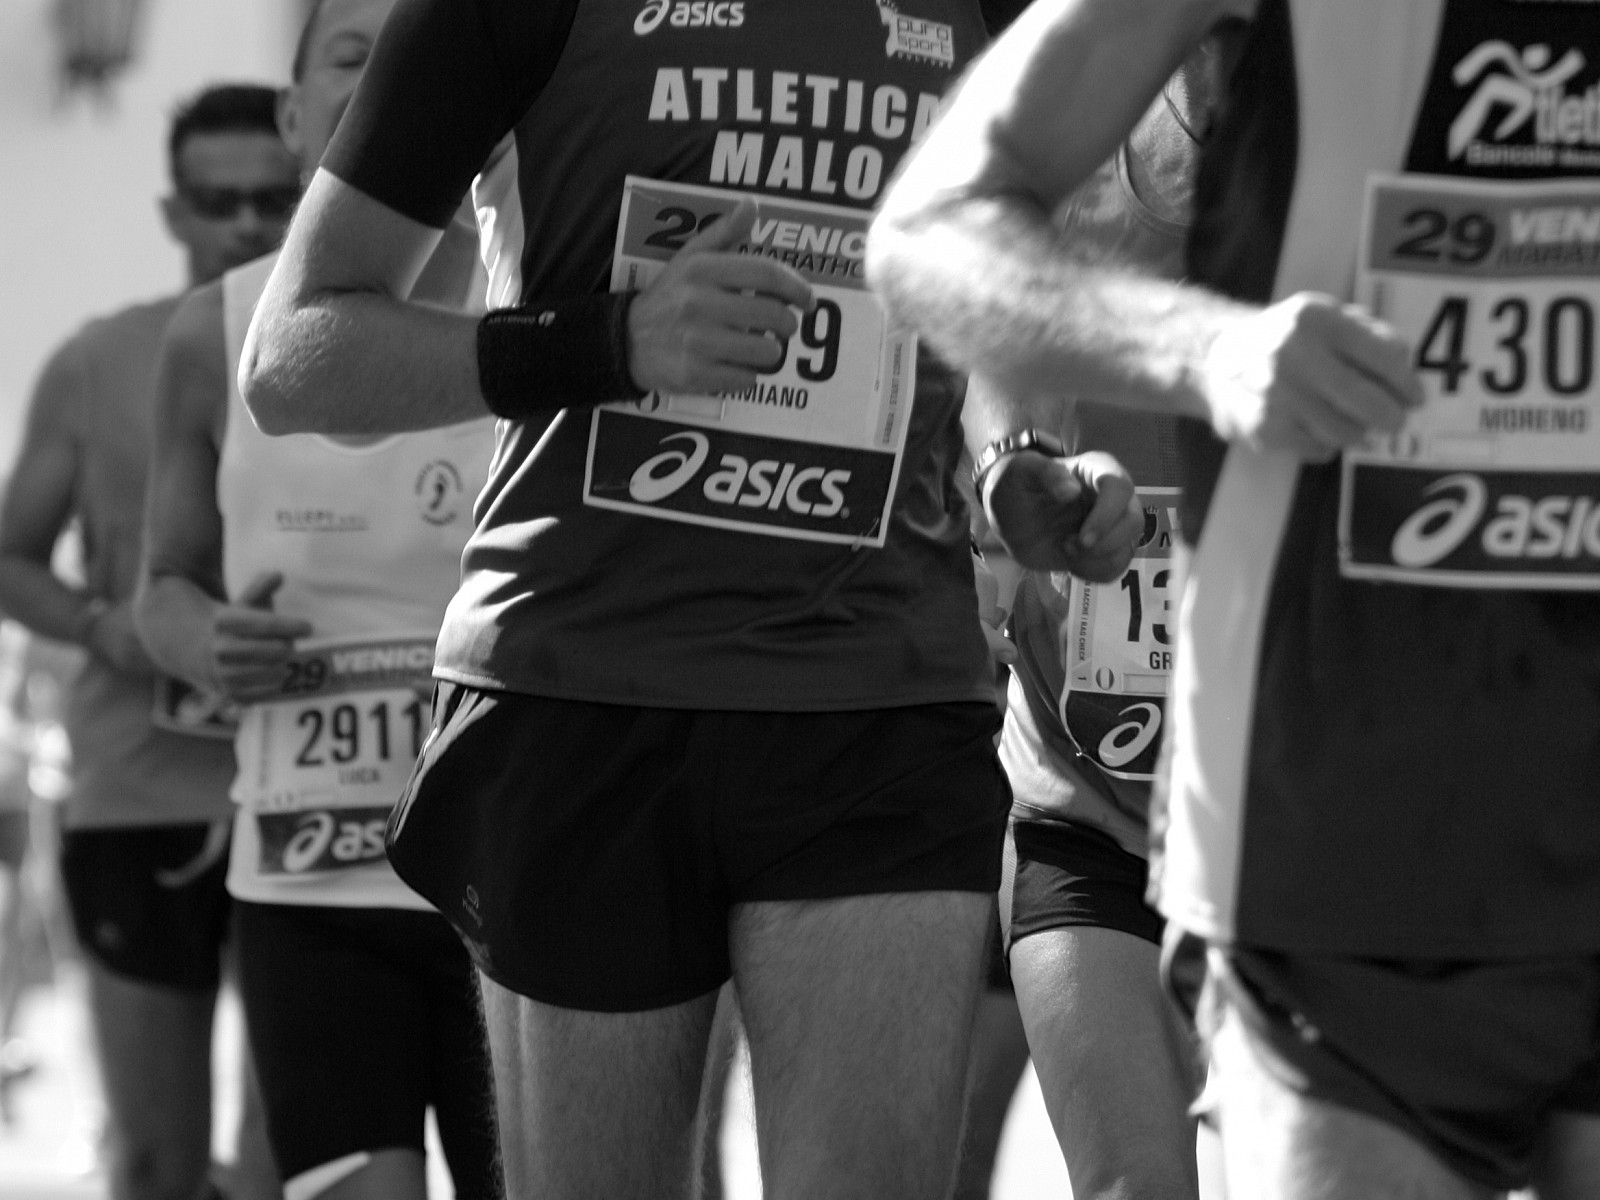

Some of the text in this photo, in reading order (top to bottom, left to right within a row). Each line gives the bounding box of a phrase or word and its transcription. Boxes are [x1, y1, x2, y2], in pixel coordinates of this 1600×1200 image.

[669, 2, 745, 27] asics
[709, 130, 883, 199] MALO
[643, 207, 866, 259] 2 VENIC
[738, 244, 866, 279] MARATHO
[1395, 206, 1600, 264] 29 VEN
[1415, 294, 1596, 396] 430
[722, 383, 809, 410] MIANO
[1479, 407, 1588, 433] MORENO
[702, 453, 851, 518] asics
[1481, 495, 1600, 559] asi
[1121, 568, 1172, 646] 13
[332, 645, 435, 676] VENIC
[295, 702, 423, 768] 2911
